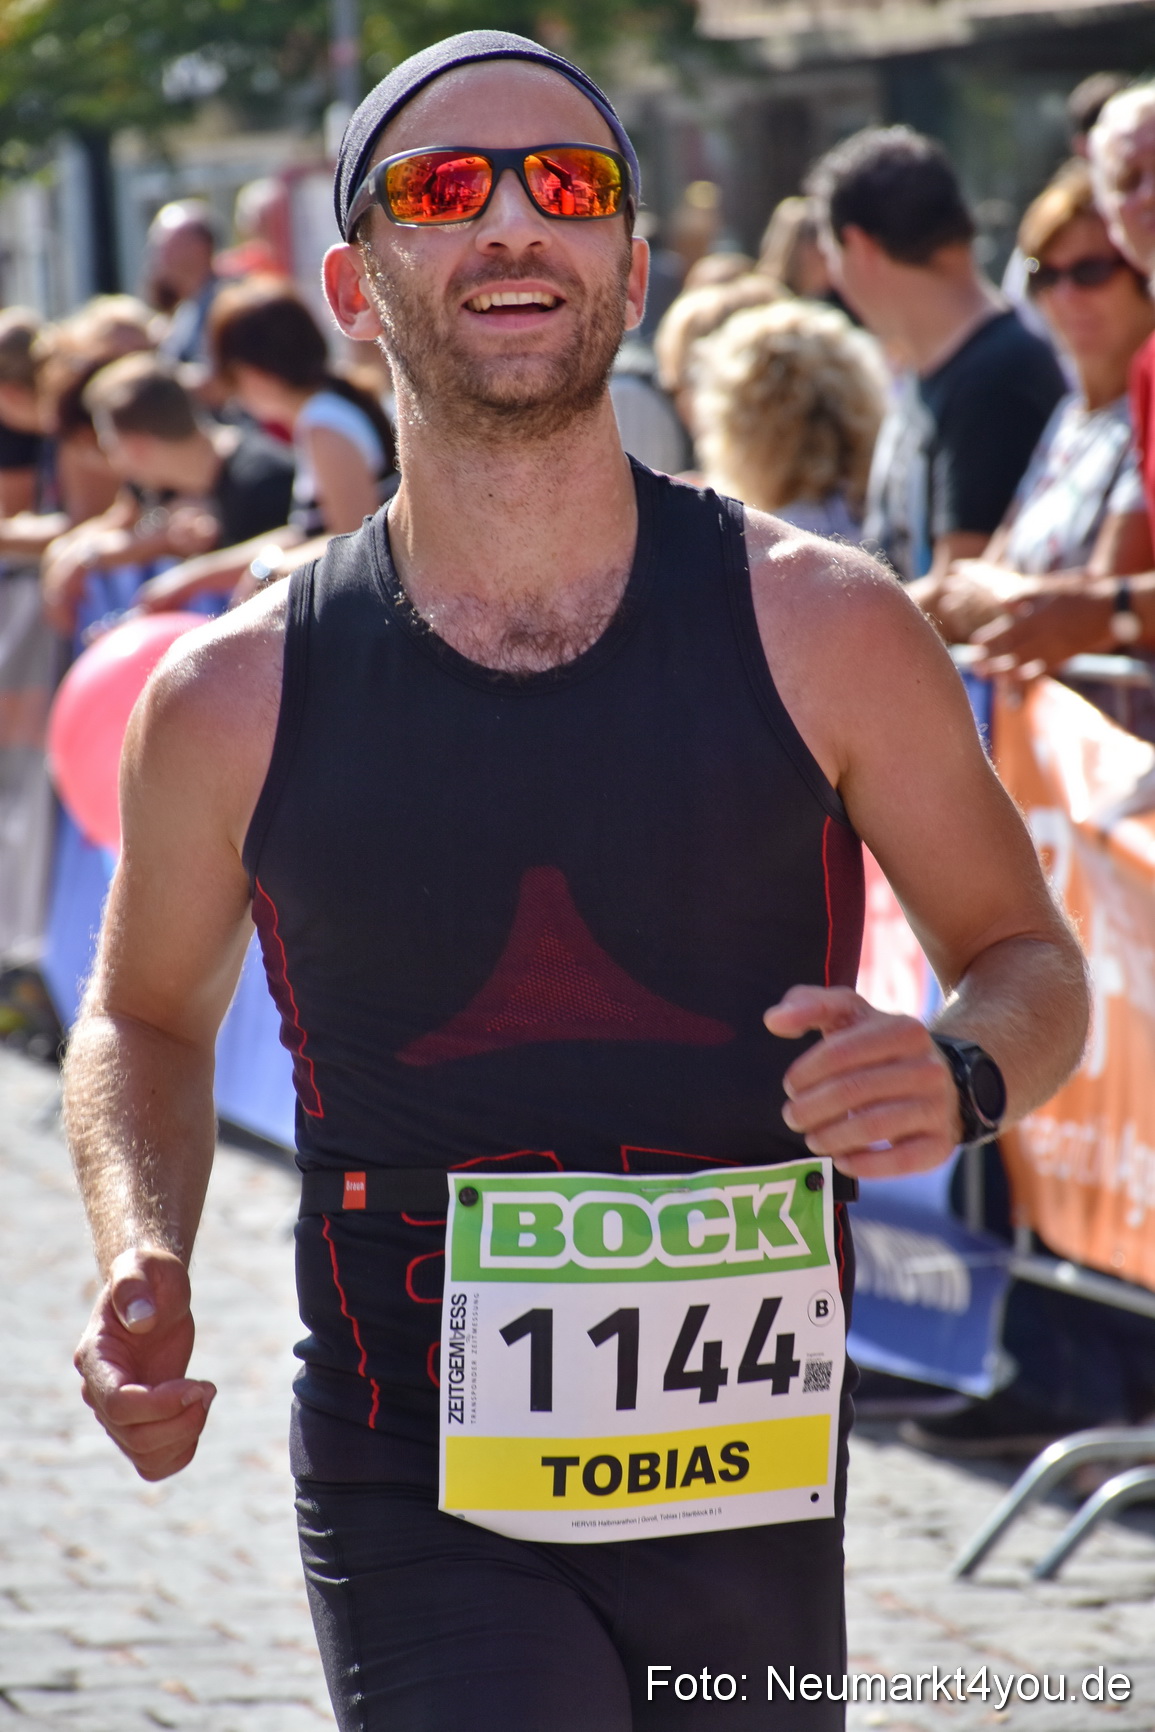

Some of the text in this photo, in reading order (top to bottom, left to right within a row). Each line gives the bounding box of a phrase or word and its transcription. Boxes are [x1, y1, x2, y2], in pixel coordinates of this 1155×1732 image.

[484, 1184, 808, 1266] BOCK
[471, 1292, 480, 1355] ZEITMESSUNG
[815, 1298, 829, 1319] B
[499, 1297, 801, 1412] 1144
[541, 1441, 751, 1497] TOBIAS
[571, 1519, 597, 1528] HERVIS
[597, 1517, 638, 1527] Halbmarathon
[660, 1513, 678, 1521] Tobias
[682, 1509, 708, 1518] Startblock
